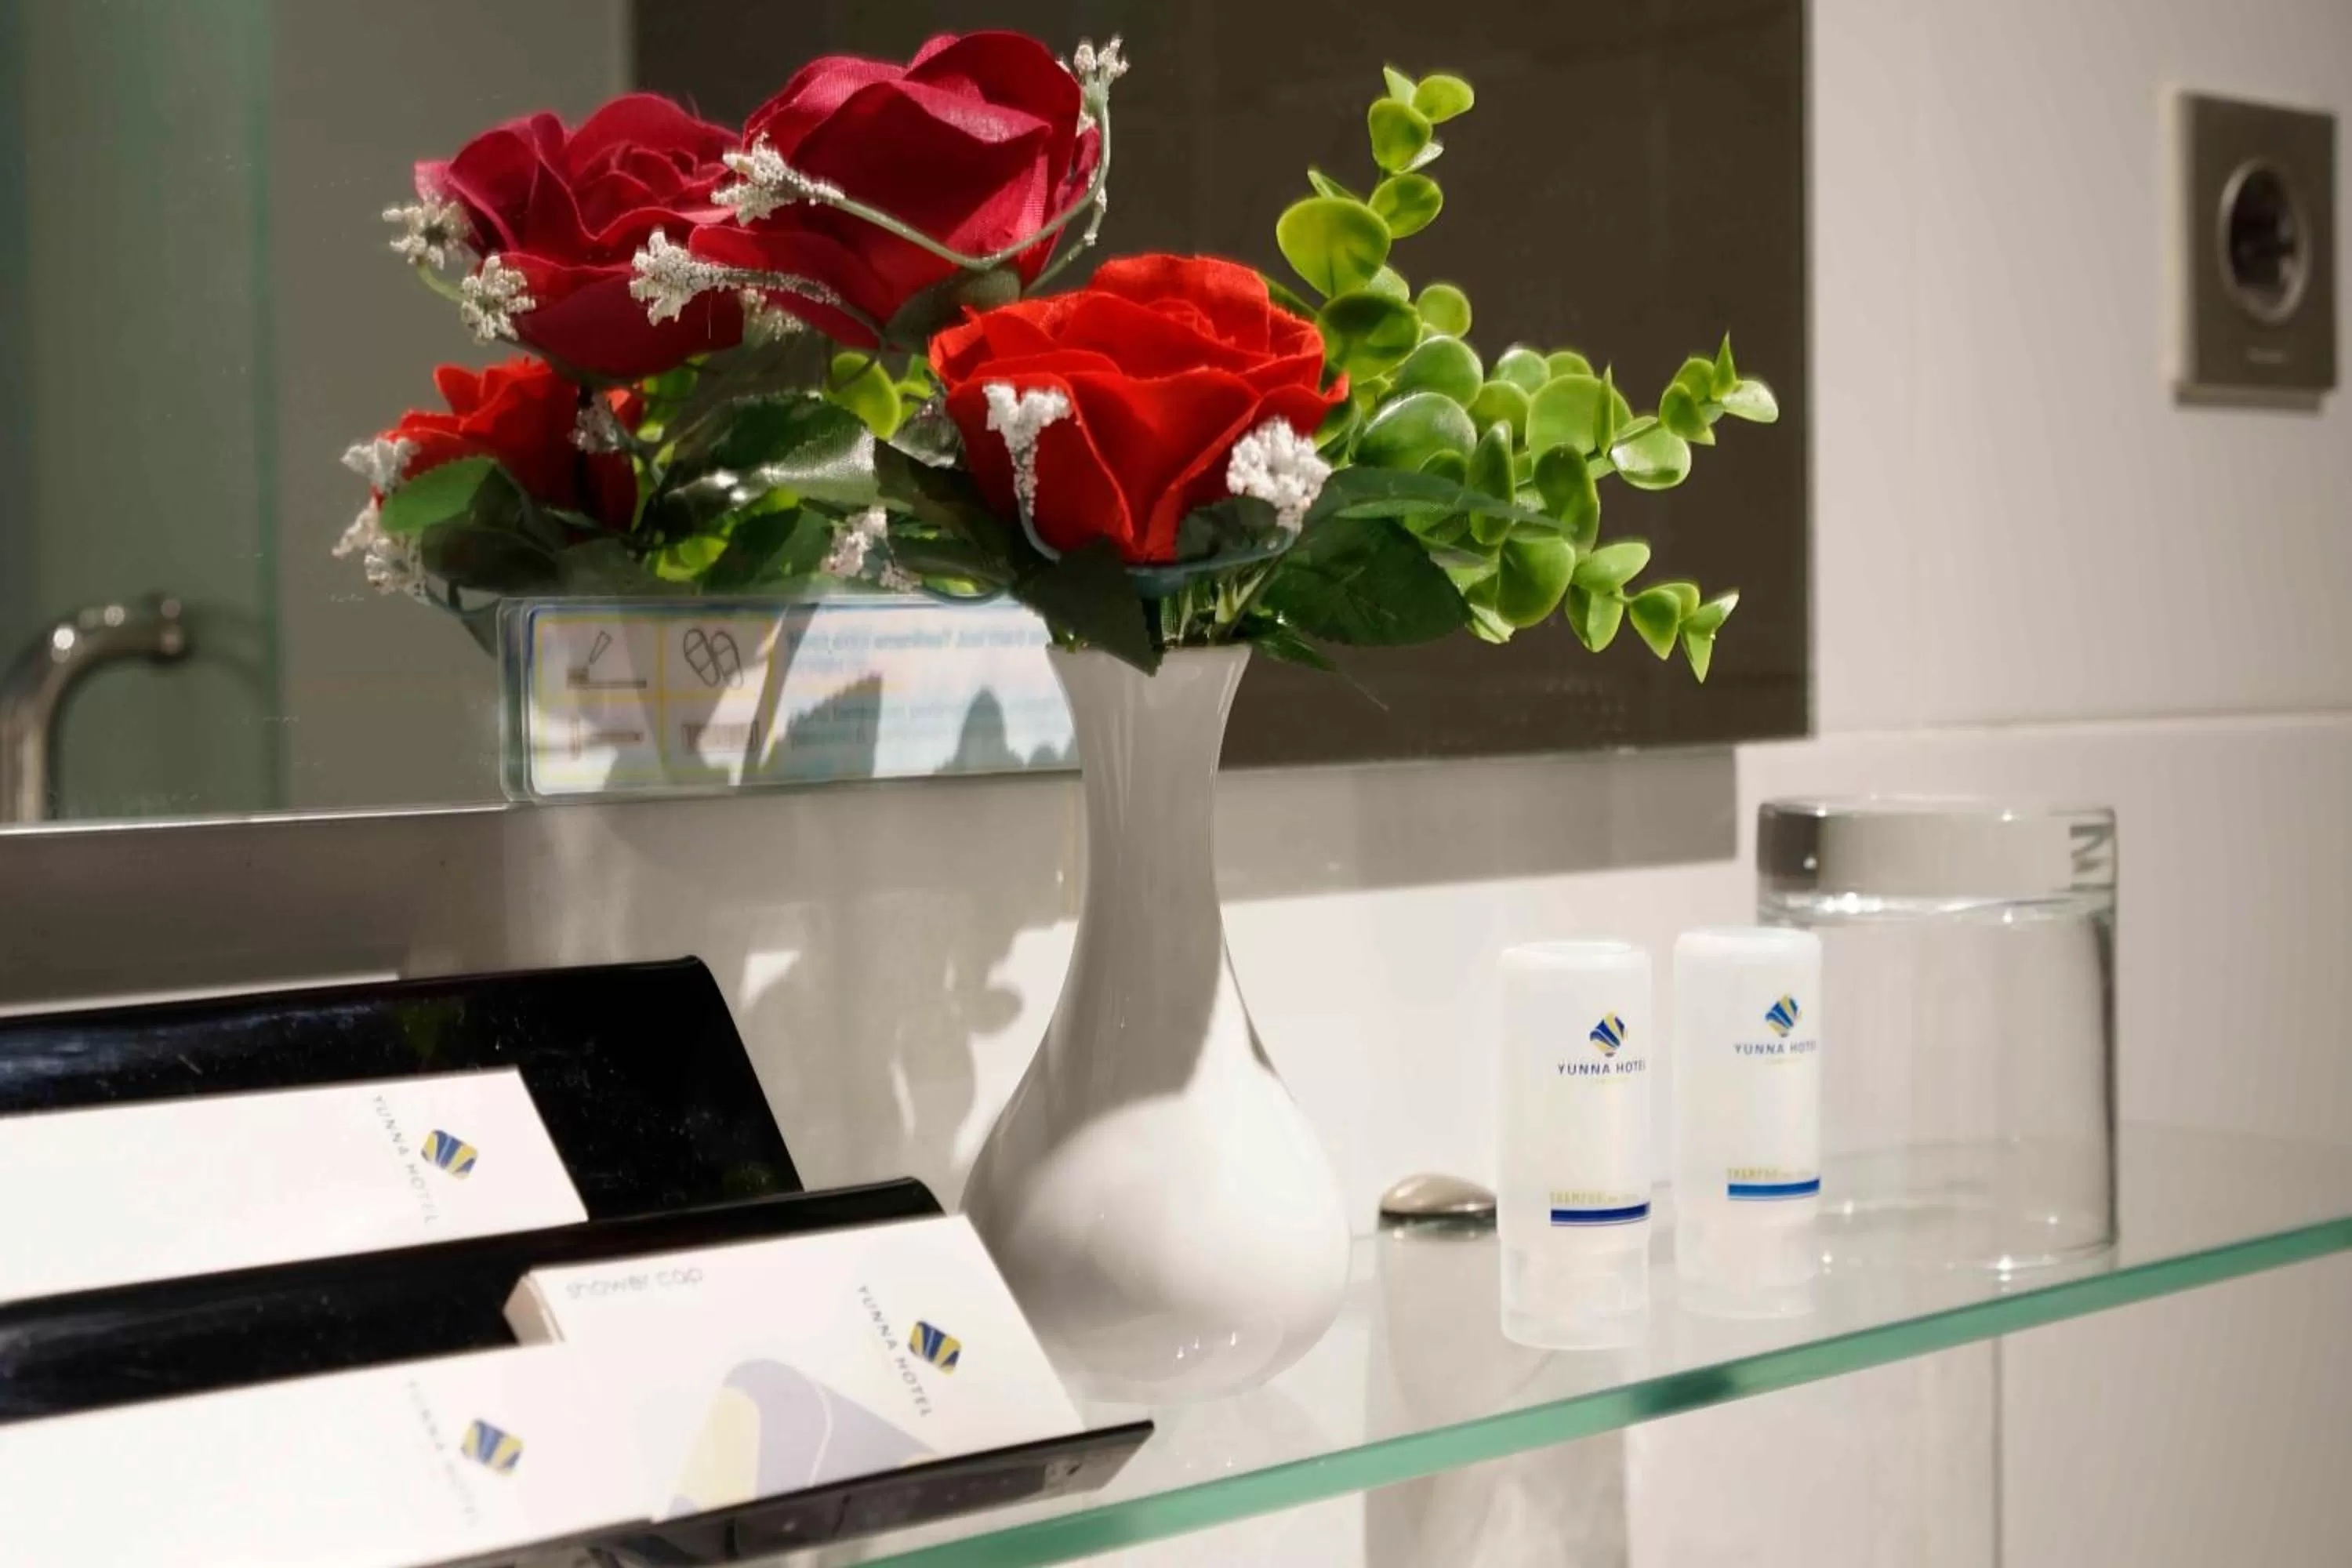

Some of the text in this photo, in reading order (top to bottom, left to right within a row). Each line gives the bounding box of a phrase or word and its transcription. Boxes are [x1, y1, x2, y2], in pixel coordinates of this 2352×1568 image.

[1733, 1042, 1785, 1055] YUNNA
[1557, 1062, 1610, 1076] YUNNA
[373, 1094, 440, 1224] YUNNA HOTEL
[564, 1265, 704, 1300] shower cap
[857, 1285, 932, 1417] YUNNA HOTEL
